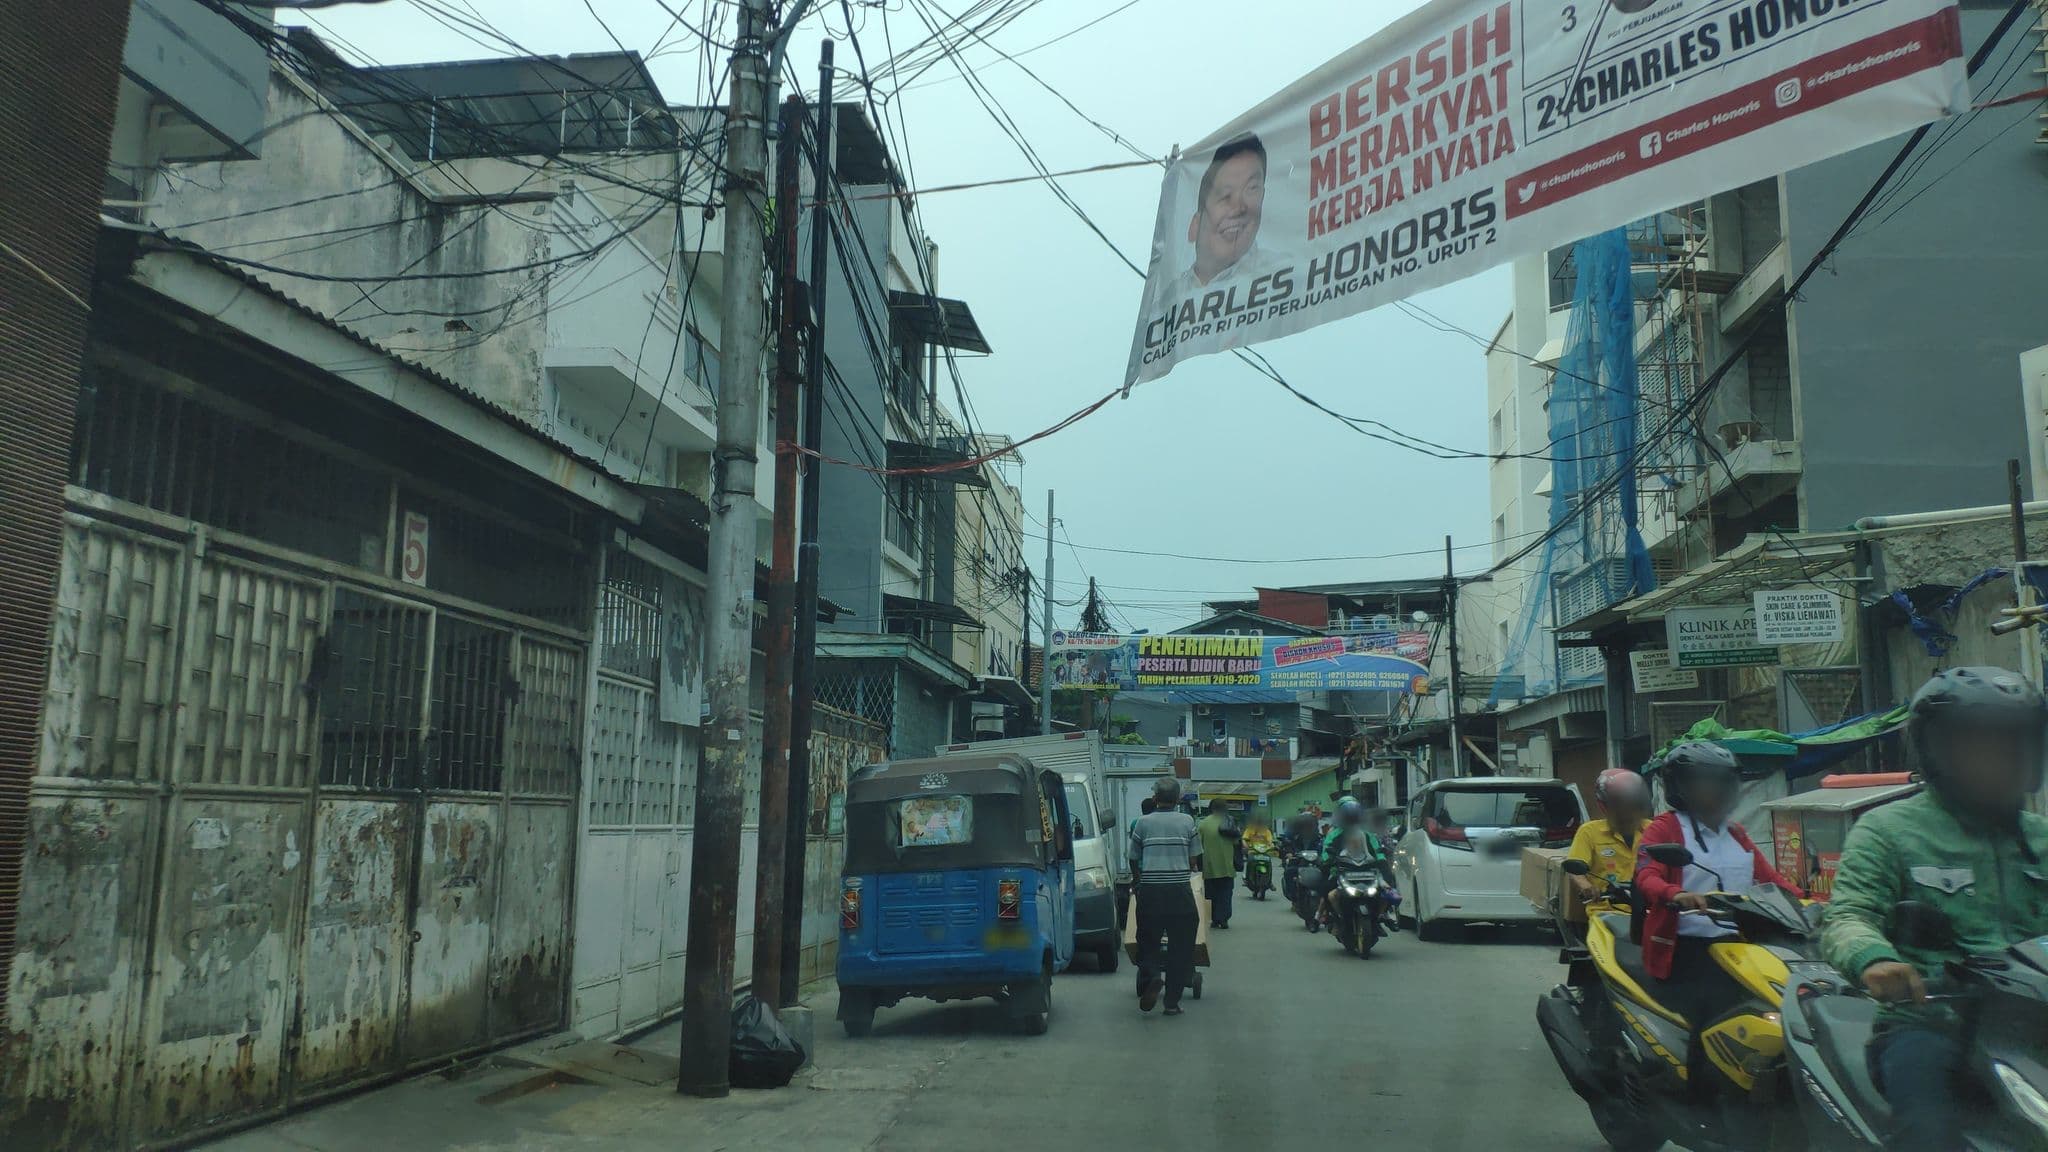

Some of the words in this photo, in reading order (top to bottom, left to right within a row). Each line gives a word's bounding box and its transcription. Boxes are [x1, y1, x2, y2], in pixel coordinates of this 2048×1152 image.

[1561, 6, 1577, 33] 3
[1623, 2, 1683, 32] PERJUANGAN
[1310, 1, 1511, 152] BERSIH
[1577, 22, 1720, 113] CHARLES
[1310, 60, 1513, 201] MERAKYAT
[1665, 119, 1710, 143] Charles
[1712, 100, 1761, 126] Honoris
[1308, 166, 1406, 241] KERJA
[1413, 117, 1516, 195] NYATA
[1145, 266, 1295, 349] CHARLES
[1307, 187, 1496, 290] HONORIS
[1143, 334, 1177, 365] CALEG
[1180, 322, 1212, 344] DPR
[1216, 319, 1231, 334] RI
[1235, 309, 1264, 328] PDI
[1268, 268, 1385, 319] PERJUANGAN
[1390, 257, 1422, 278] NO.
[1428, 233, 1480, 265] URUT
[1485, 227, 1497, 246] 2
[404, 518, 427, 581] 5
[1799, 593, 1829, 601] DOKTER
[1679, 620, 1730, 634] KLINIK
[1797, 609, 1836, 621] LIENAWATI
[1139, 636, 1264, 657] PENERIMAAN
[1137, 657, 1188, 673] PESERTA
[1190, 658, 1226, 674] DIDIK
[1227, 659, 1262, 674] BARU
[1270, 671, 1299, 680] SEKOLAH
[1137, 675, 1164, 686] TAHUN
[1165, 674, 1212, 686] PELAJARAN
[1213, 674, 1261, 686] 2019-2020
[1270, 680, 1299, 689] SEKOLAH
